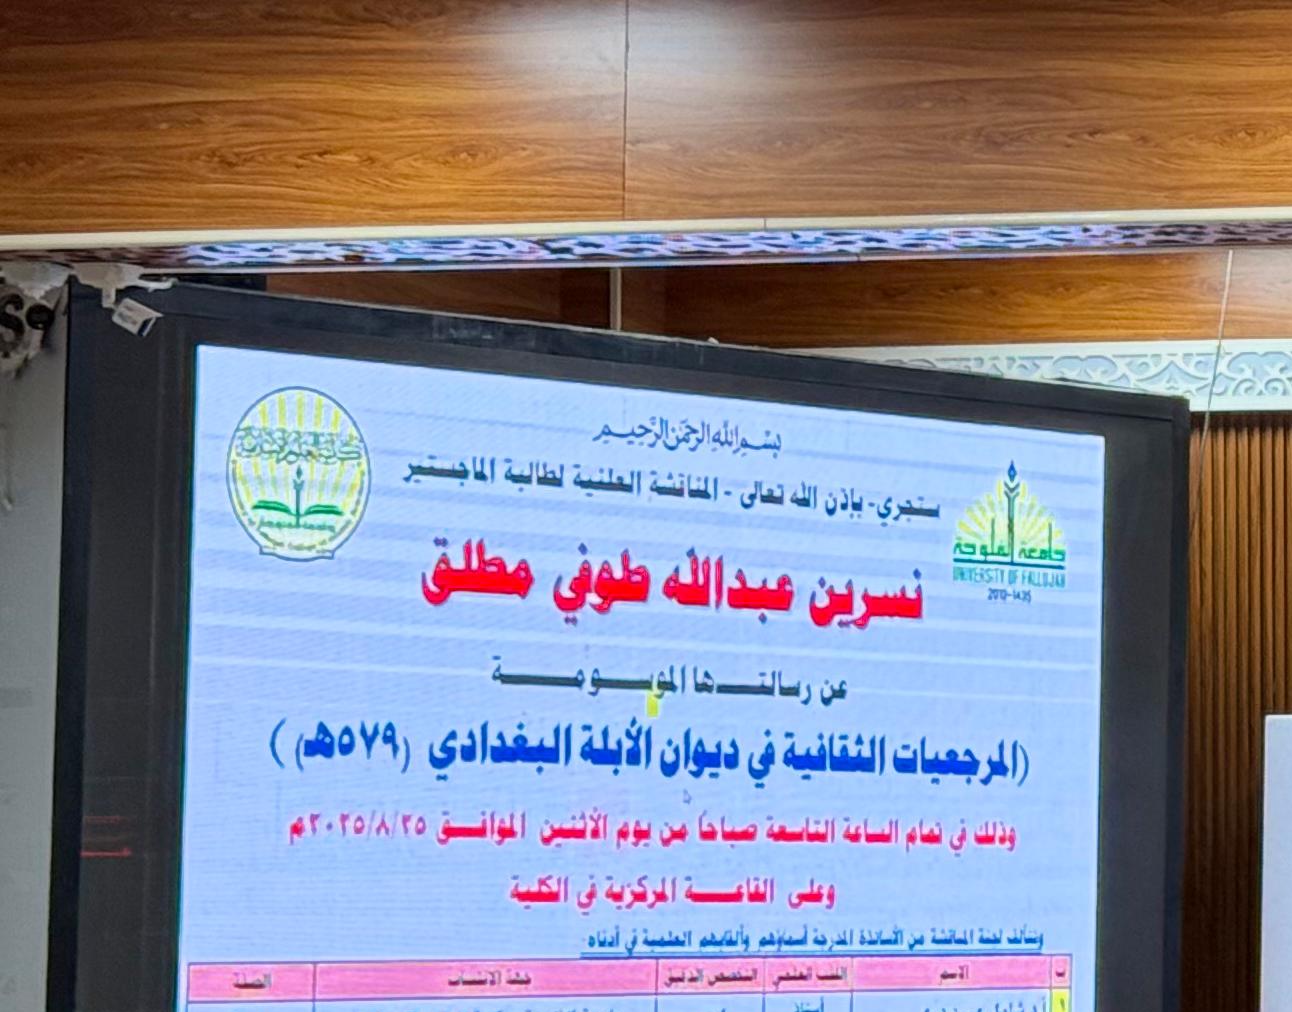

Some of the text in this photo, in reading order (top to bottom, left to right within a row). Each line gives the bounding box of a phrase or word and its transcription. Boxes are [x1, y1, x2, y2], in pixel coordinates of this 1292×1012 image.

[403, 455, 496, 486] الماجستير
[504, 458, 564, 492] لطالبة
[573, 463, 641, 497] العلنية
[650, 470, 718, 500] المناقشة
[740, 481, 784, 509] تعالى
[790, 481, 817, 509] الله
[421, 537, 922, 629] نسرين عبدالله طوفي مطلق
[819, 679, 848, 705] عن
[428, 720, 572, 782] البغدادي
[659, 728, 740, 779] ديوان
[748, 729, 776, 789] في
[782, 731, 886, 781] الثقافية
[436, 810, 526, 846] الموافق
[616, 813, 651, 849] يوم
[659, 818, 689, 847] من
[766, 815, 836, 844] التاسعة
[843, 816, 899, 844] الساعة
[905, 818, 943, 852] تمام
[949, 818, 967, 858] في
[973, 821, 1017, 852] وذلك
[510, 874, 836, 915] وعلى القاعة المركزية في الكلية
[625, 928, 638, 955] في
[908, 931, 925, 950] من
